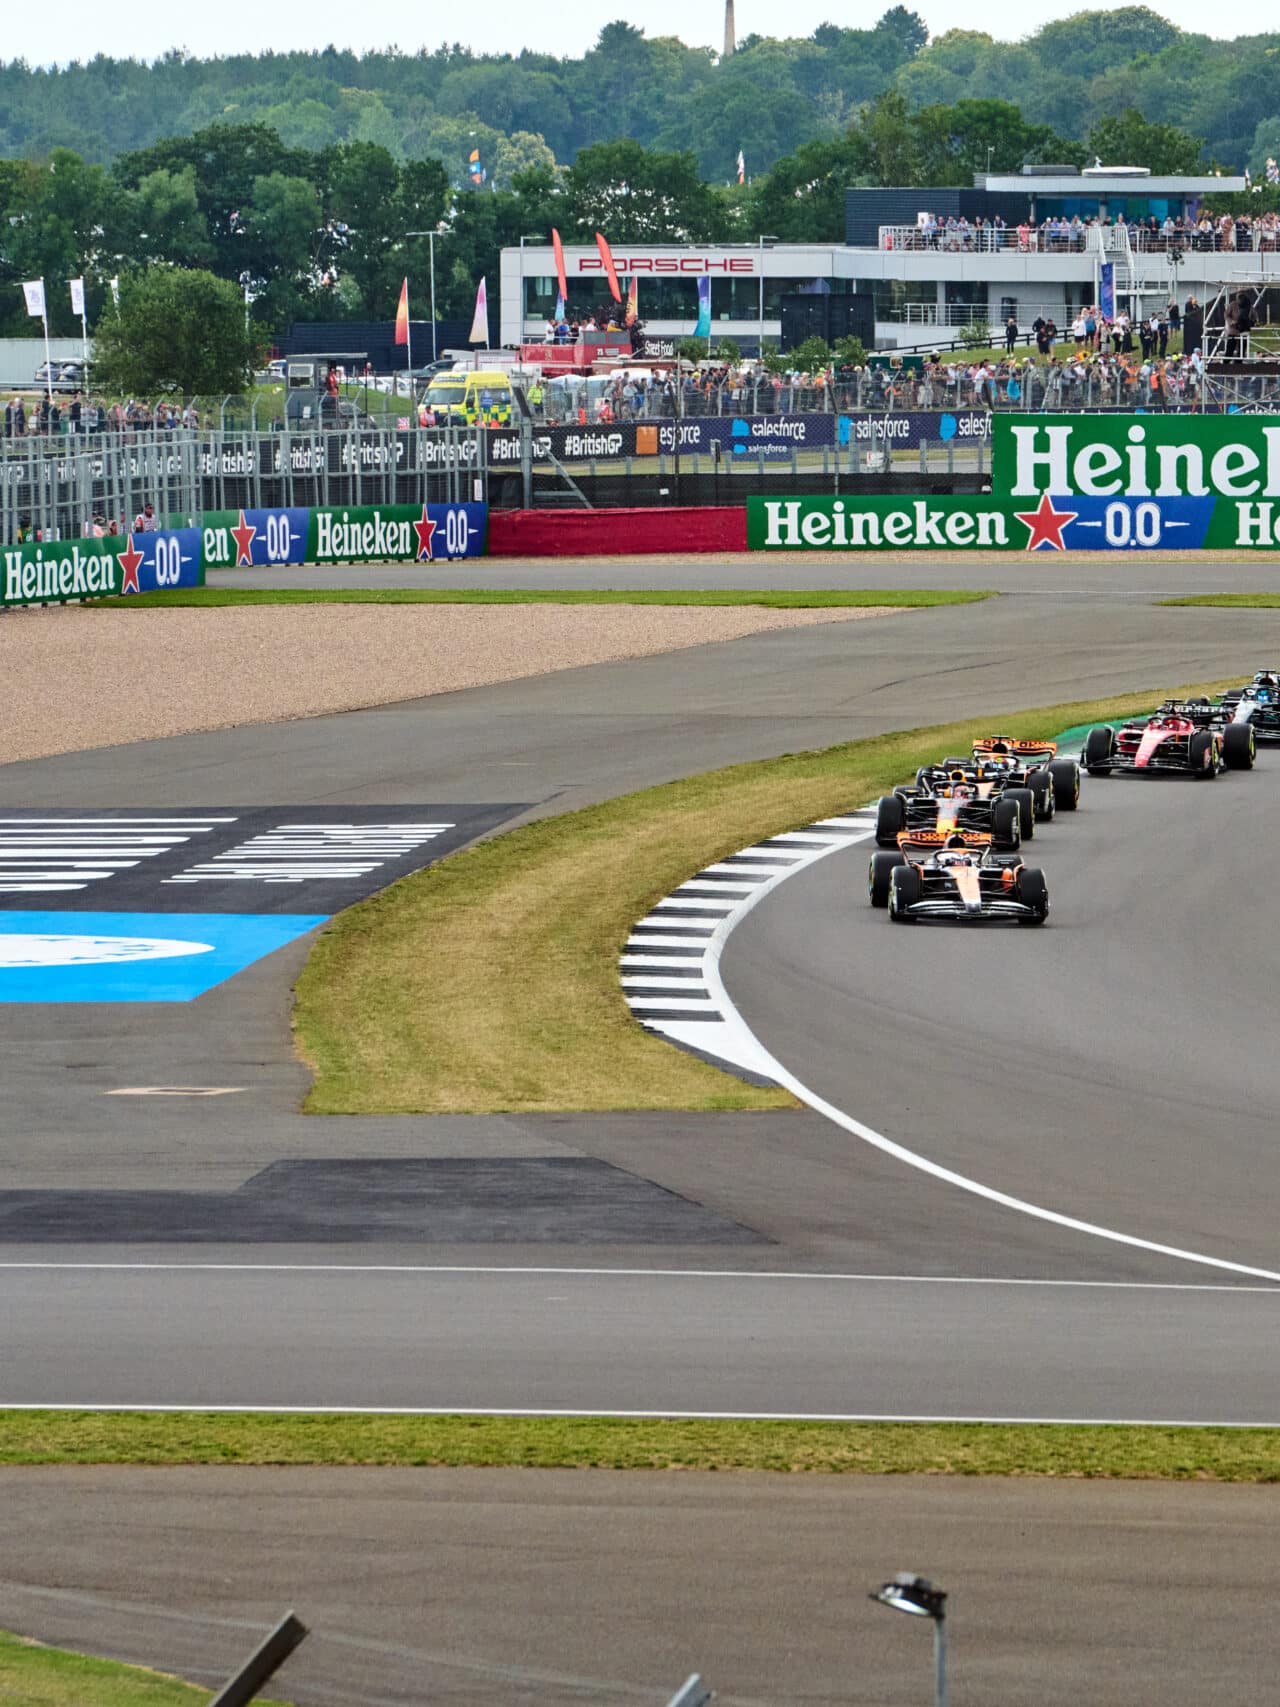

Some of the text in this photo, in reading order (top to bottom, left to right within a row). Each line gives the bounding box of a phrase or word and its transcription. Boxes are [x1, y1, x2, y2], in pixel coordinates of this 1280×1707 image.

[579, 258, 754, 272] PORSCHE
[564, 433, 622, 456] #BritishGP
[266, 514, 291, 561] 0.0
[316, 509, 468, 557] Heineken 0.0
[764, 500, 1163, 546] Heineken 0.0
[4, 546, 115, 600] Heineken
[155, 536, 181, 586] 0.0
